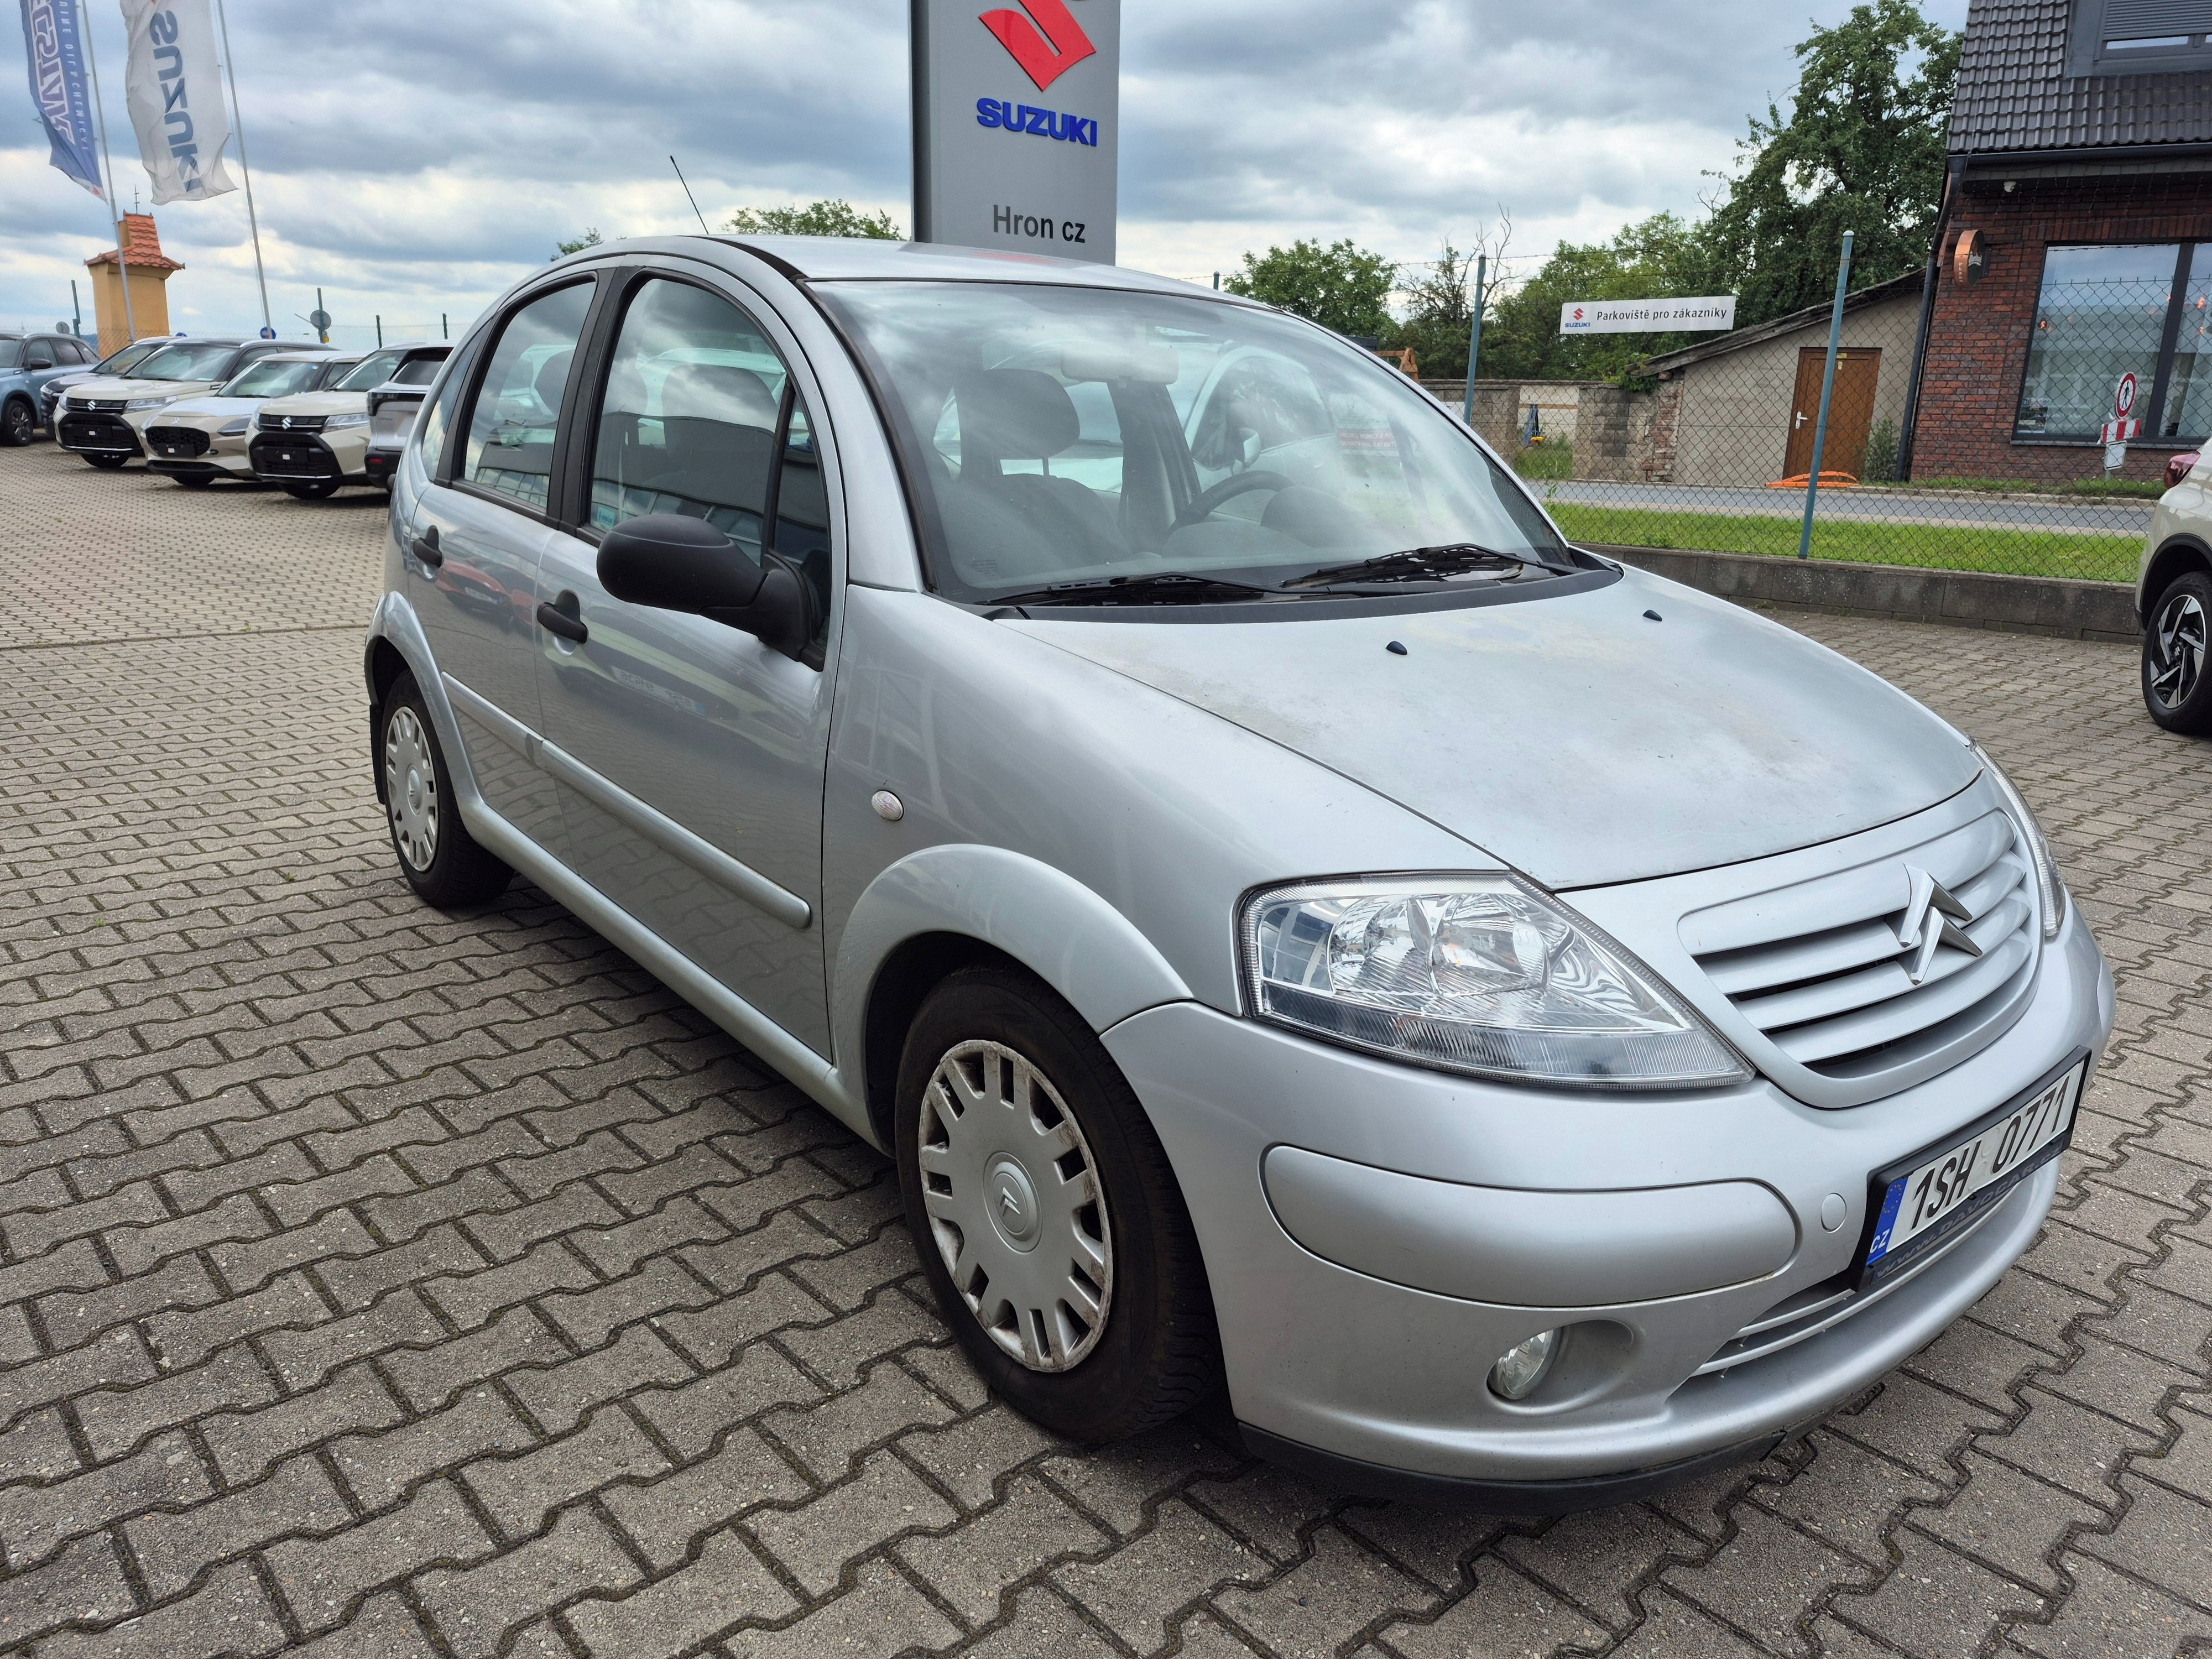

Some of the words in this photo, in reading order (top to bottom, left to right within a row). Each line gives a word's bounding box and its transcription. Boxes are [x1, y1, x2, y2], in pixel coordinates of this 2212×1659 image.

[977, 97, 1098, 147] SUZUKI
[993, 204, 1053, 239] Hron
[1062, 221, 1086, 243] cz
[1597, 310, 1650, 321] Parkoviště
[1652, 311, 1670, 321] pro
[1672, 307, 1727, 320] zákazníky
[1911, 1140, 1982, 1230] 1SH
[1991, 1075, 2070, 1174] 0771
[1870, 1228, 1890, 1254] CZ
